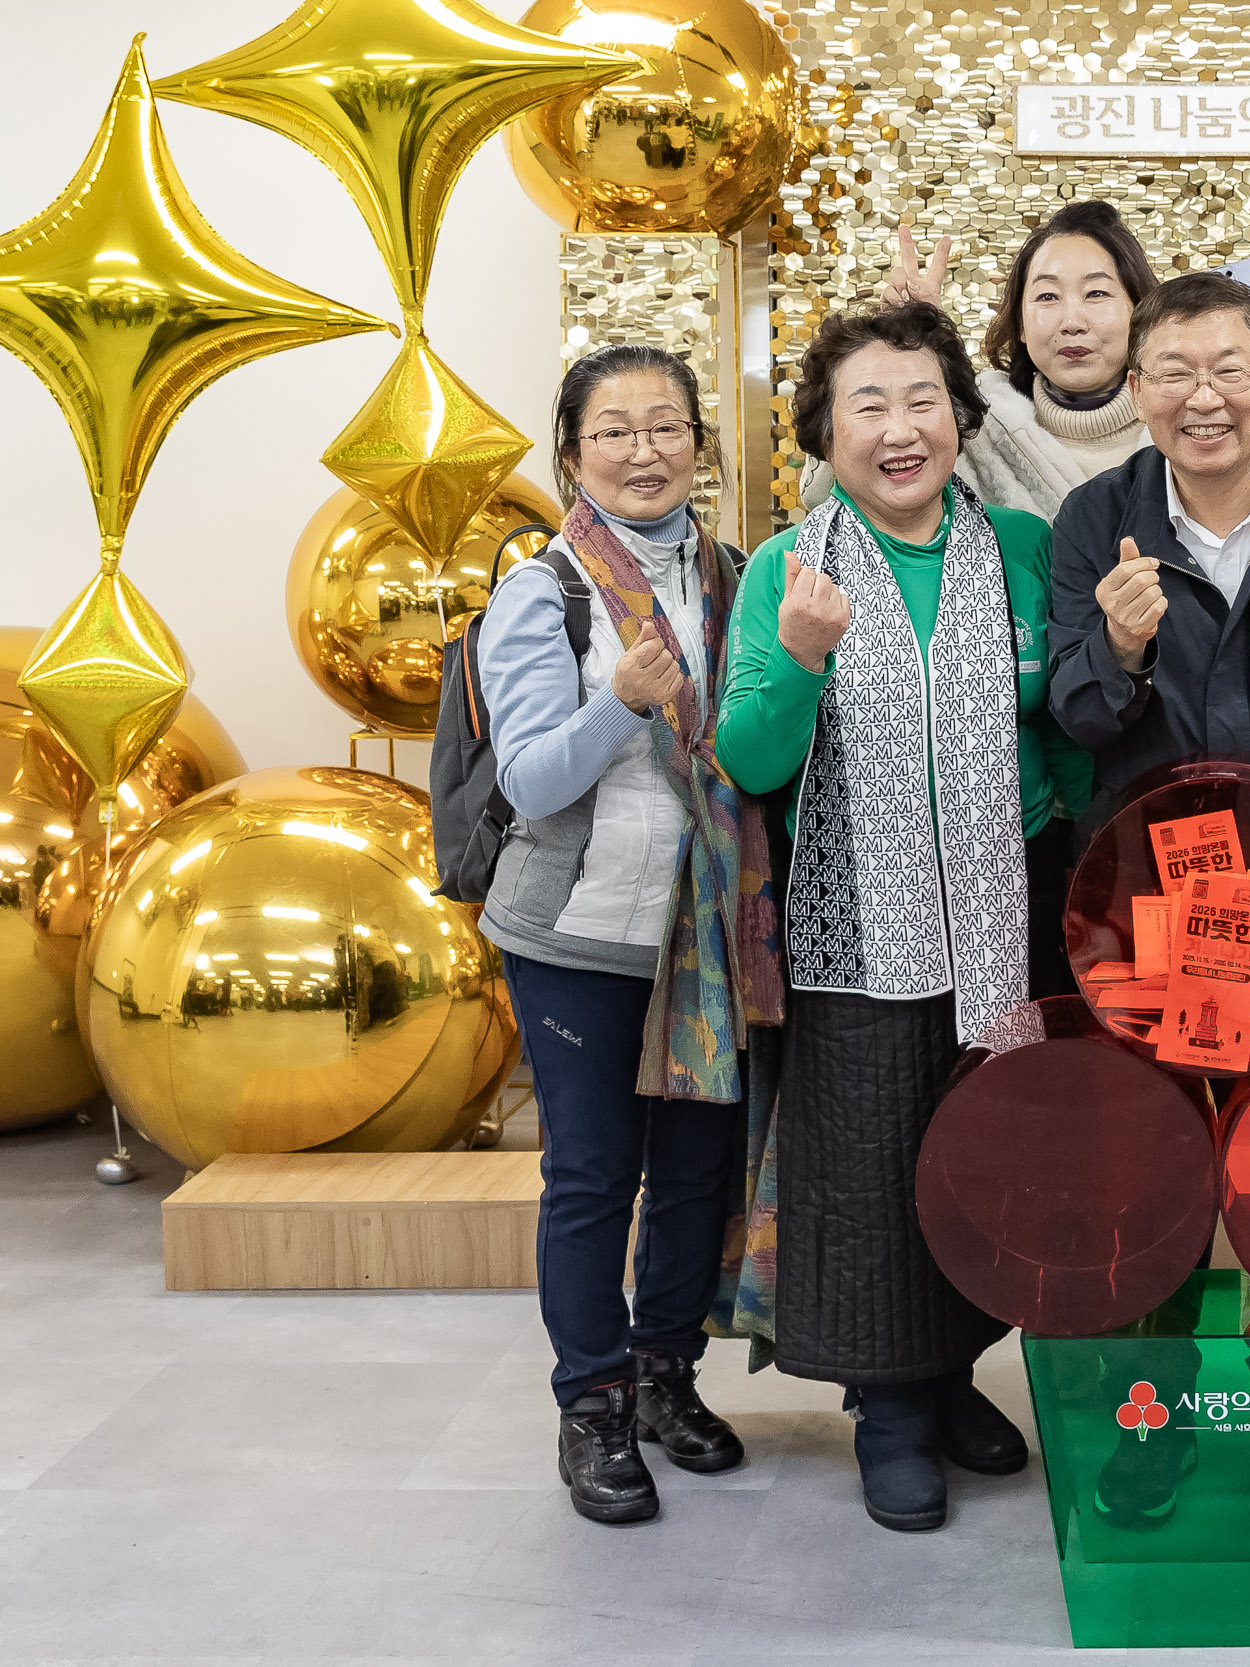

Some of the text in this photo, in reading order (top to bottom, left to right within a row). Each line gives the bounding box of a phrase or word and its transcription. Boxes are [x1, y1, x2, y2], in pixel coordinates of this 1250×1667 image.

[1050, 94, 1135, 139] 광진
[1166, 848, 1190, 860] 2026
[1191, 904, 1217, 916] 2026
